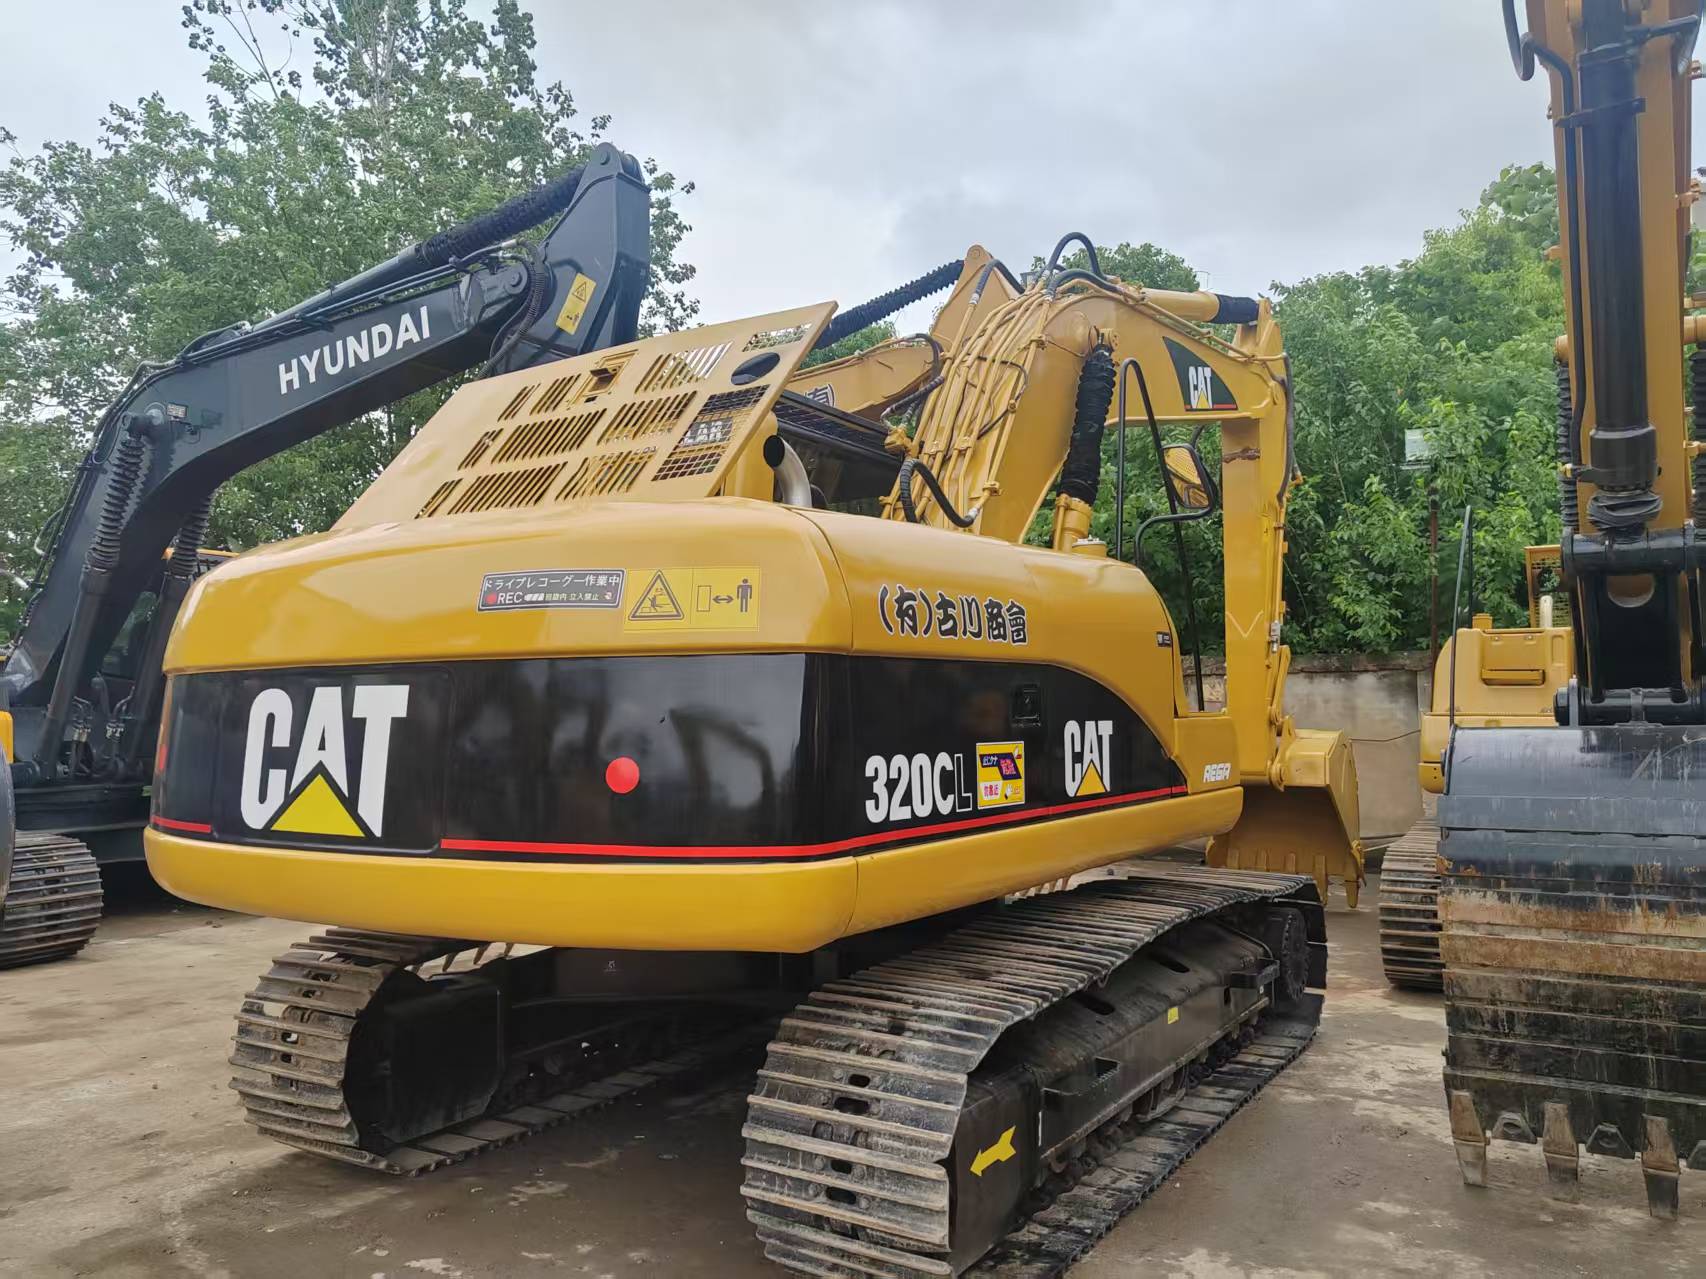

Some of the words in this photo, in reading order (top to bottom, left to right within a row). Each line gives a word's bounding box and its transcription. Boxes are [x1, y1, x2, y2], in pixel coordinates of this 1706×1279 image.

[278, 305, 430, 395] HYUNDAI
[1188, 366, 1213, 409] CAT
[497, 592, 523, 605] REC
[240, 684, 410, 838] CAT
[1063, 719, 1113, 798] CAT
